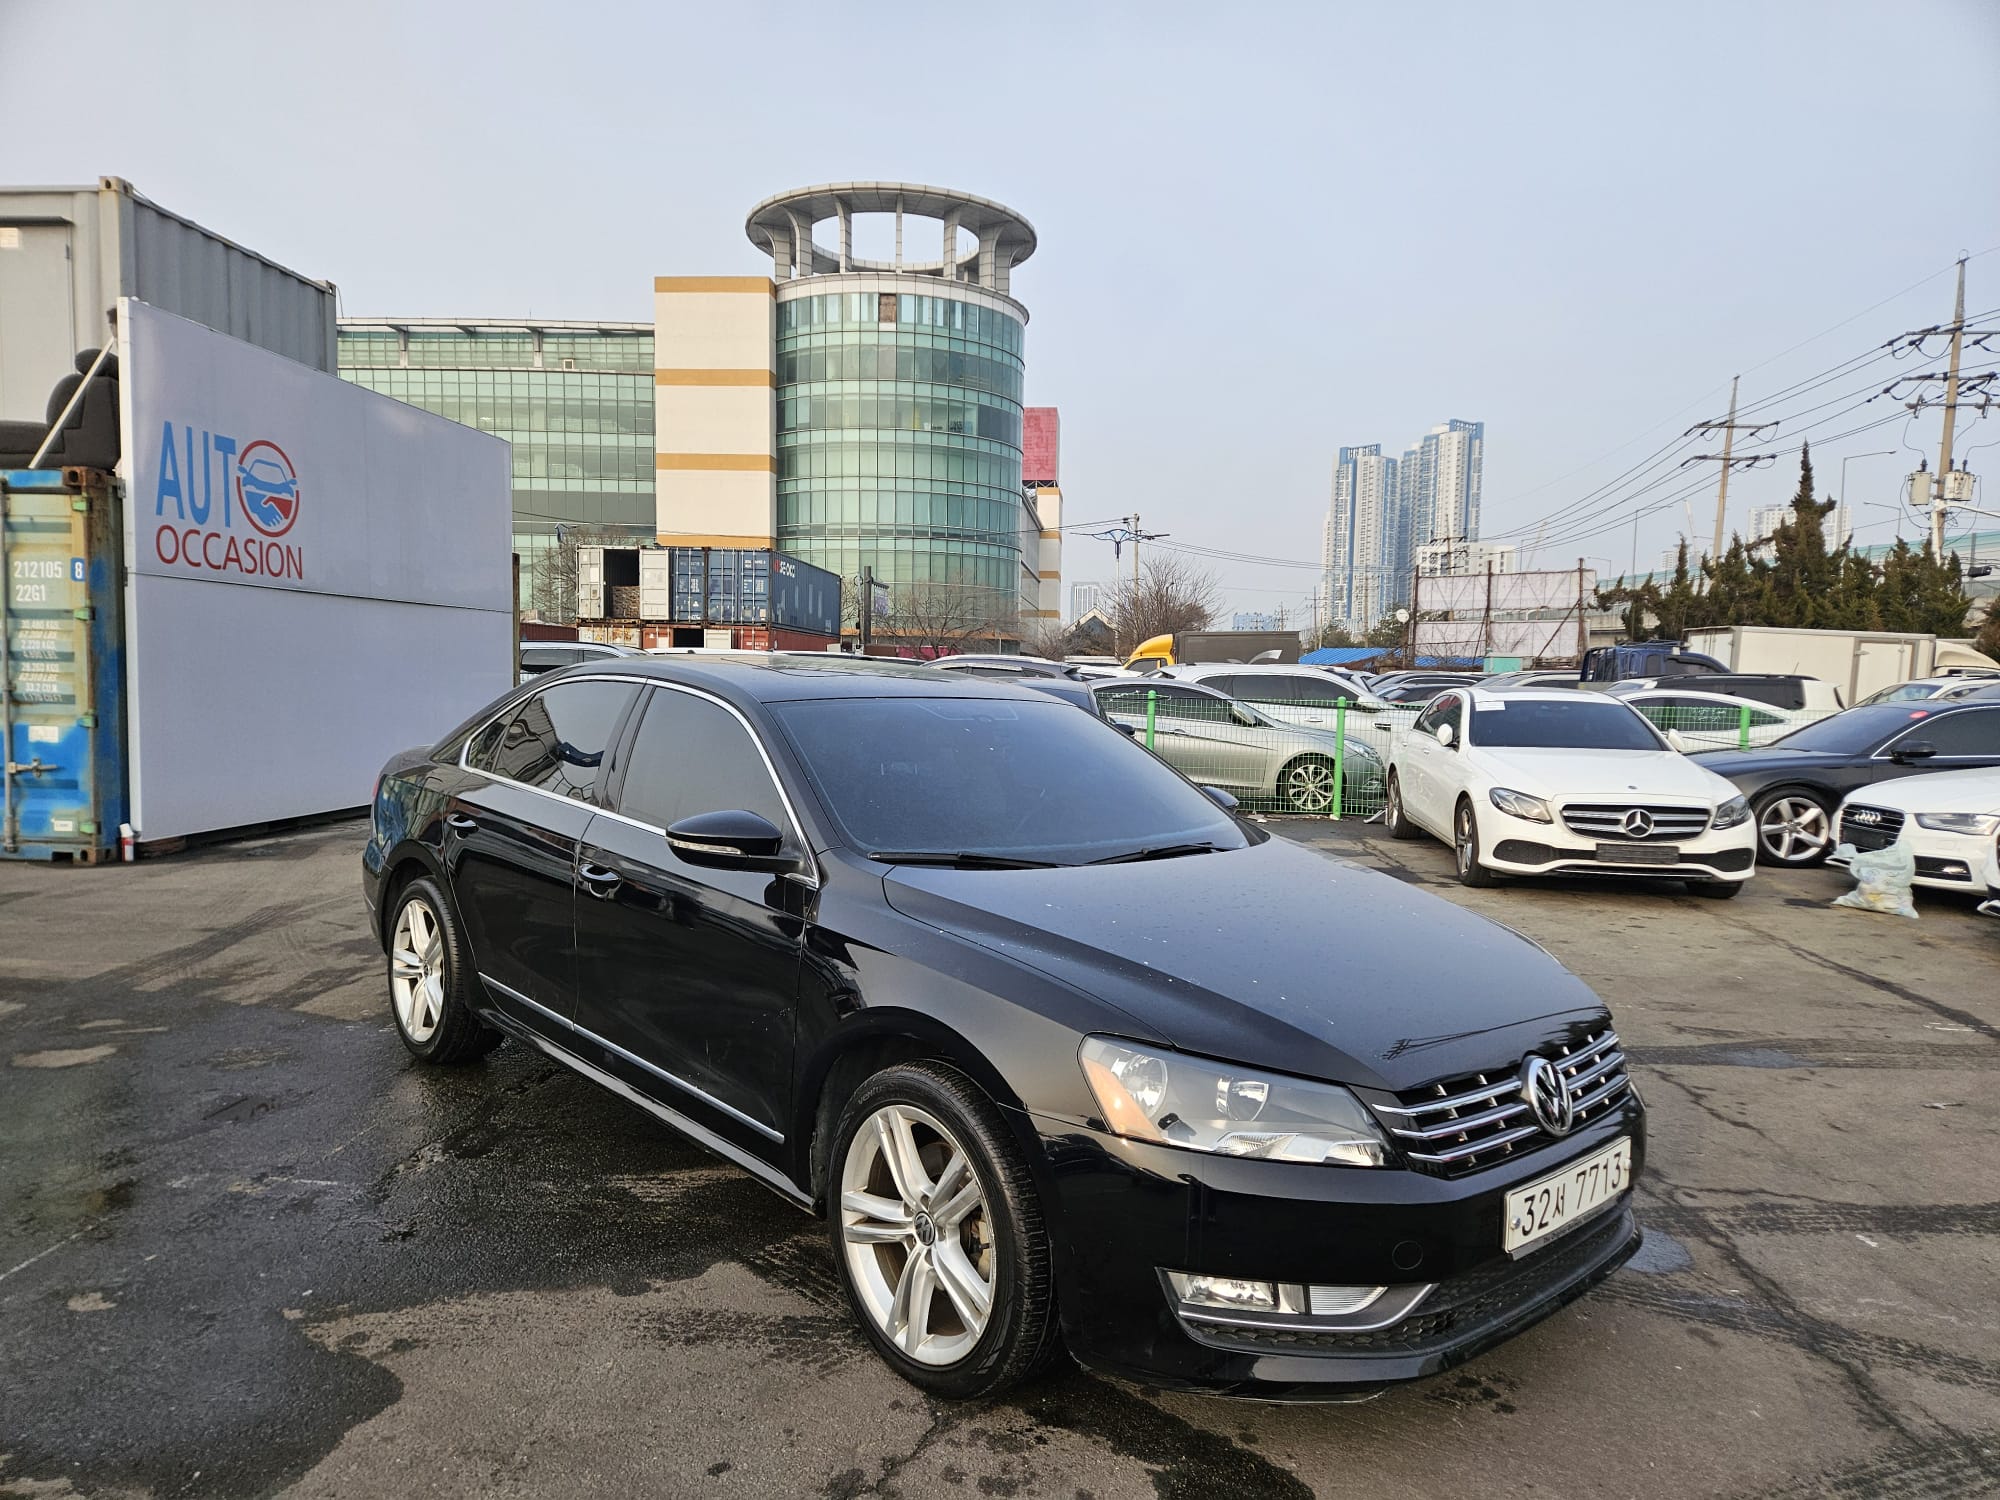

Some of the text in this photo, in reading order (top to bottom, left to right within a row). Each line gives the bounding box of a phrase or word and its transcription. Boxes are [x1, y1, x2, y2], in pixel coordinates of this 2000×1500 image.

[14, 560, 83, 579] 212105 8
[155, 524, 303, 580] OCCASION
[16, 584, 46, 601] 22G1
[1521, 1183, 1566, 1236] 32서
[1575, 1151, 1622, 1209] 7713
